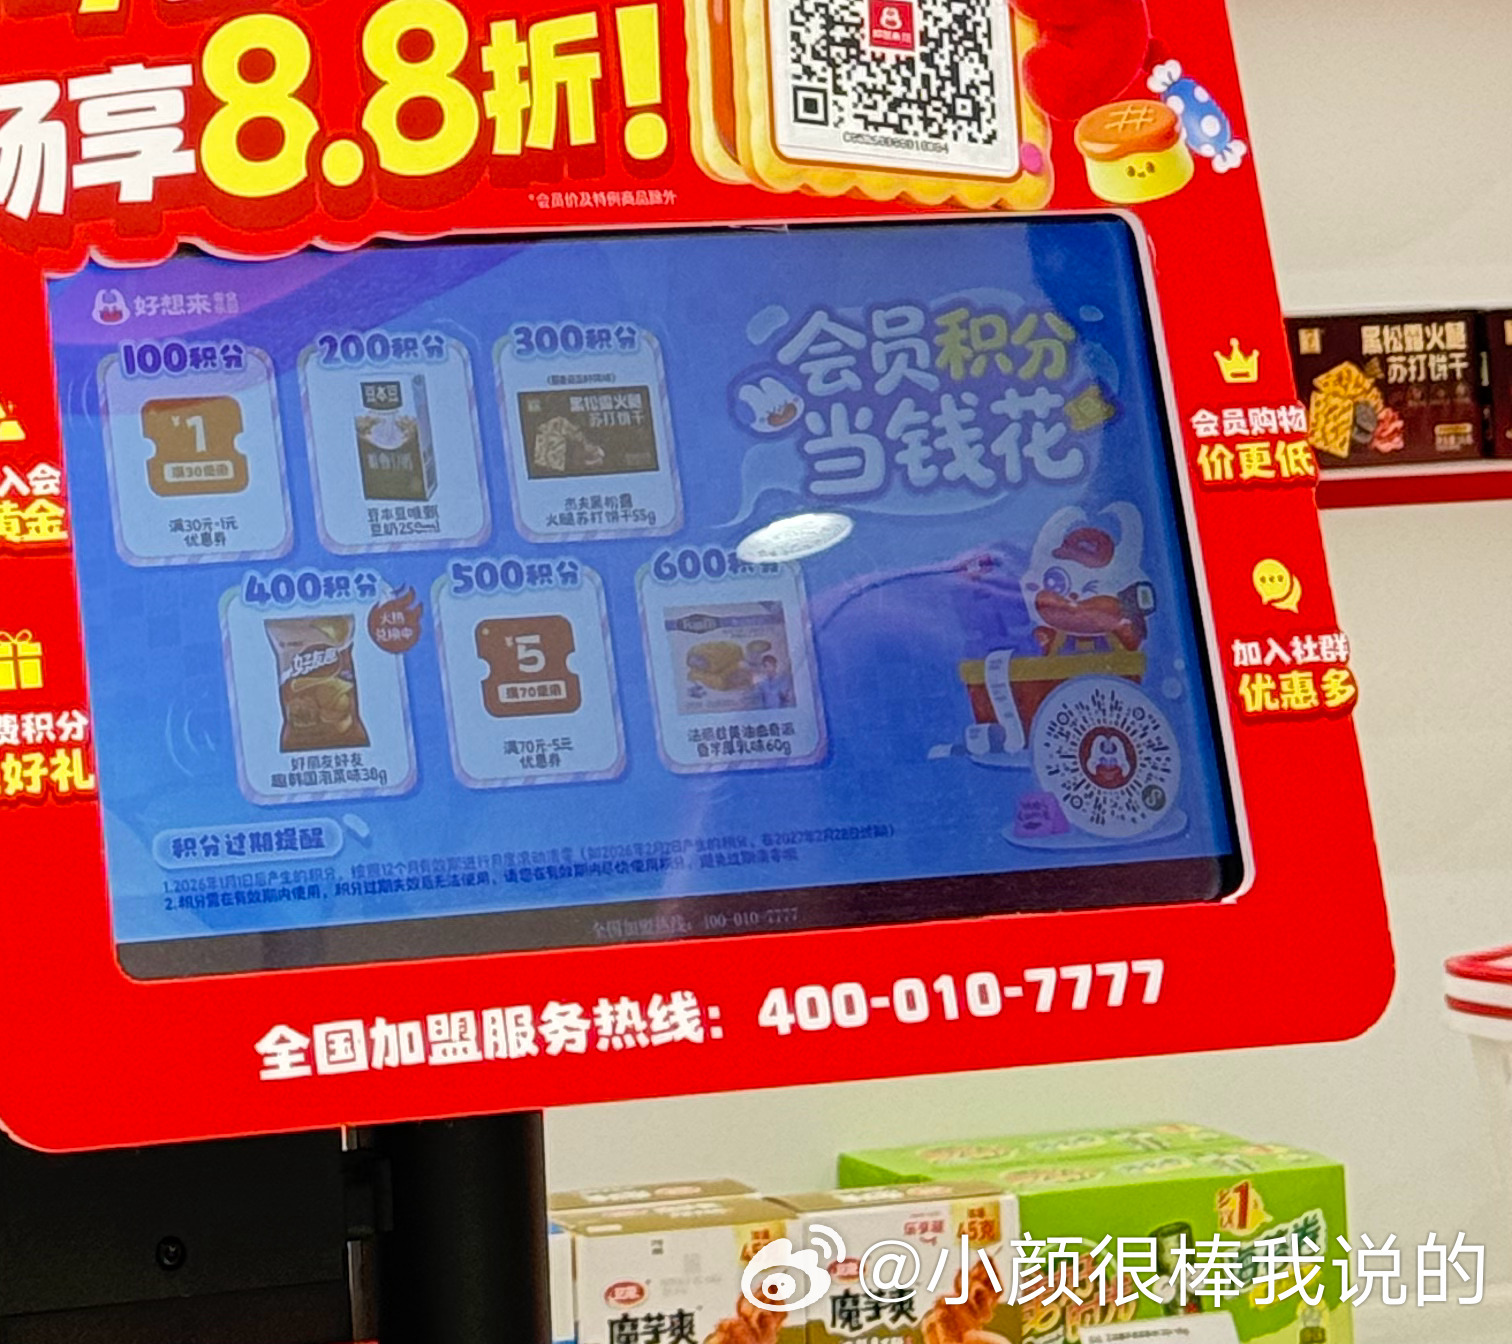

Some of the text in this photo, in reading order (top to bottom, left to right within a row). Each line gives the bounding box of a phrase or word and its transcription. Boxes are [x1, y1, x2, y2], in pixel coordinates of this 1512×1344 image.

[133, 291, 212, 318] 好想来
[318, 333, 446, 365] 200积分
[513, 324, 637, 356] 300积分
[775, 304, 1078, 398] 会员积分
[123, 342, 244, 376] 100积分
[1386, 352, 1470, 385] 苏打饼干
[1190, 405, 1308, 438] 会员购物
[802, 385, 1086, 496] 当钱花
[1196, 440, 1315, 482] 价更低
[245, 572, 378, 604] 400积分
[451, 559, 579, 594] 500积分
[1231, 632, 1350, 667] 加入社群
[1238, 667, 1357, 713] 优惠多
[171, 826, 326, 859] 积分过期提醒
[758, 958, 1165, 1036] 400-010-7777
